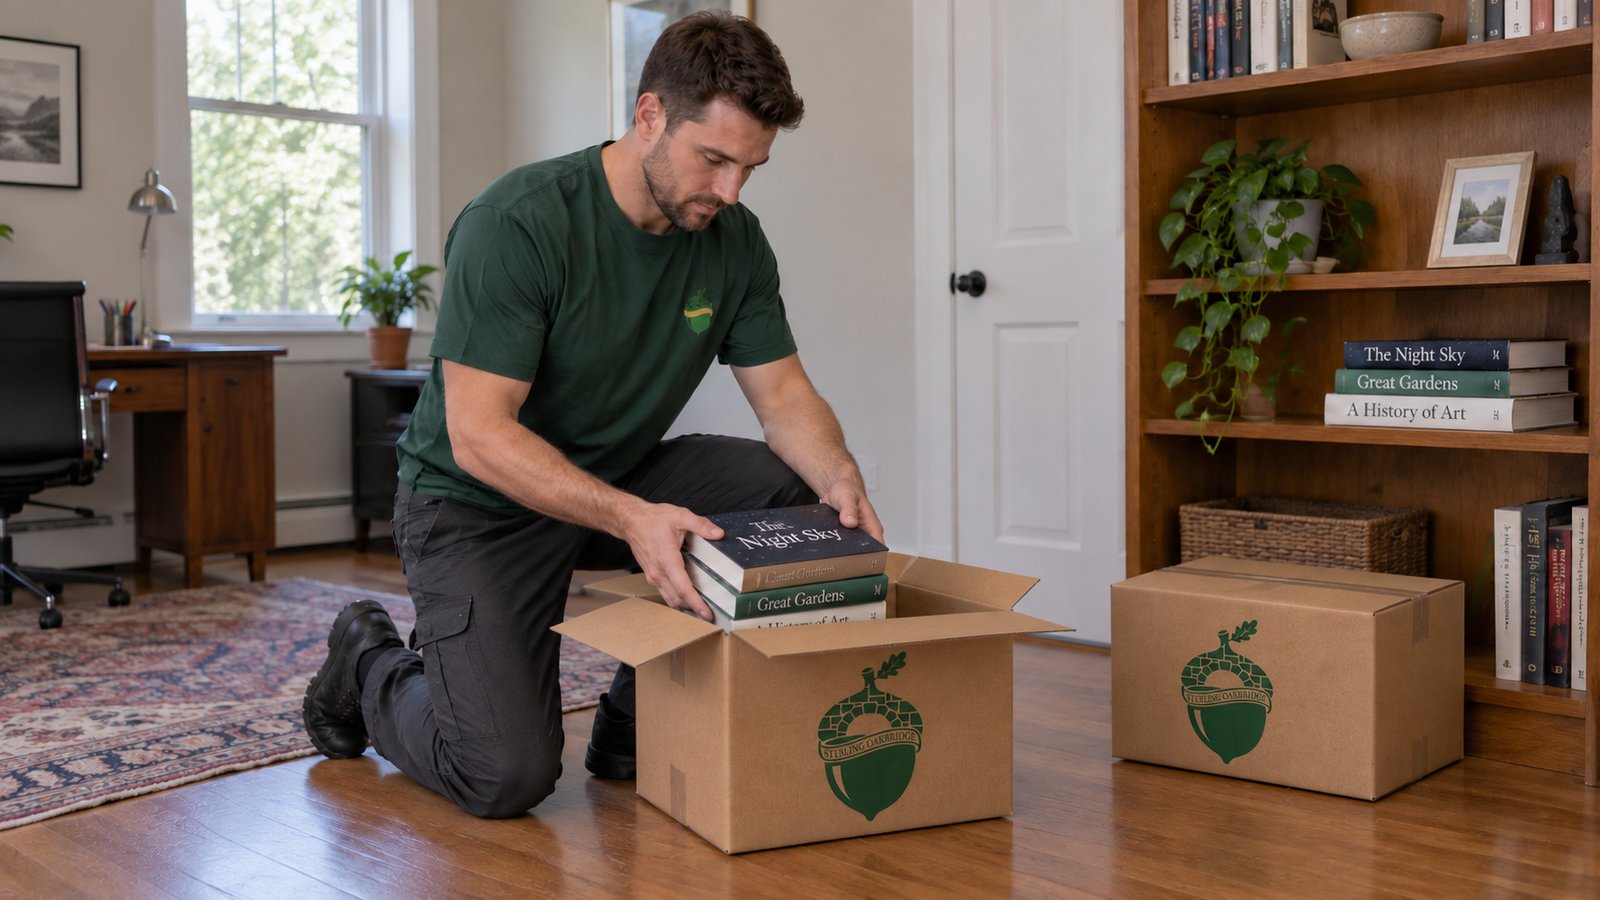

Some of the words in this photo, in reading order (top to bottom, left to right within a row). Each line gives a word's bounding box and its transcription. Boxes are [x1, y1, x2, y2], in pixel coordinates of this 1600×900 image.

[1364, 346, 1392, 362] The
[1395, 346, 1435, 366] Night
[1439, 346, 1466, 366] Sky
[1357, 374, 1396, 390] Great
[1399, 374, 1458, 391] Gardens
[1347, 402, 1359, 417] A
[1364, 402, 1418, 423] History
[1422, 404, 1438, 419] of
[1441, 405, 1467, 420] Art
[736, 532, 804, 550] Night
[802, 528, 842, 541] Sky
[757, 596, 791, 612] Great
[794, 589, 845, 607] Gardens
